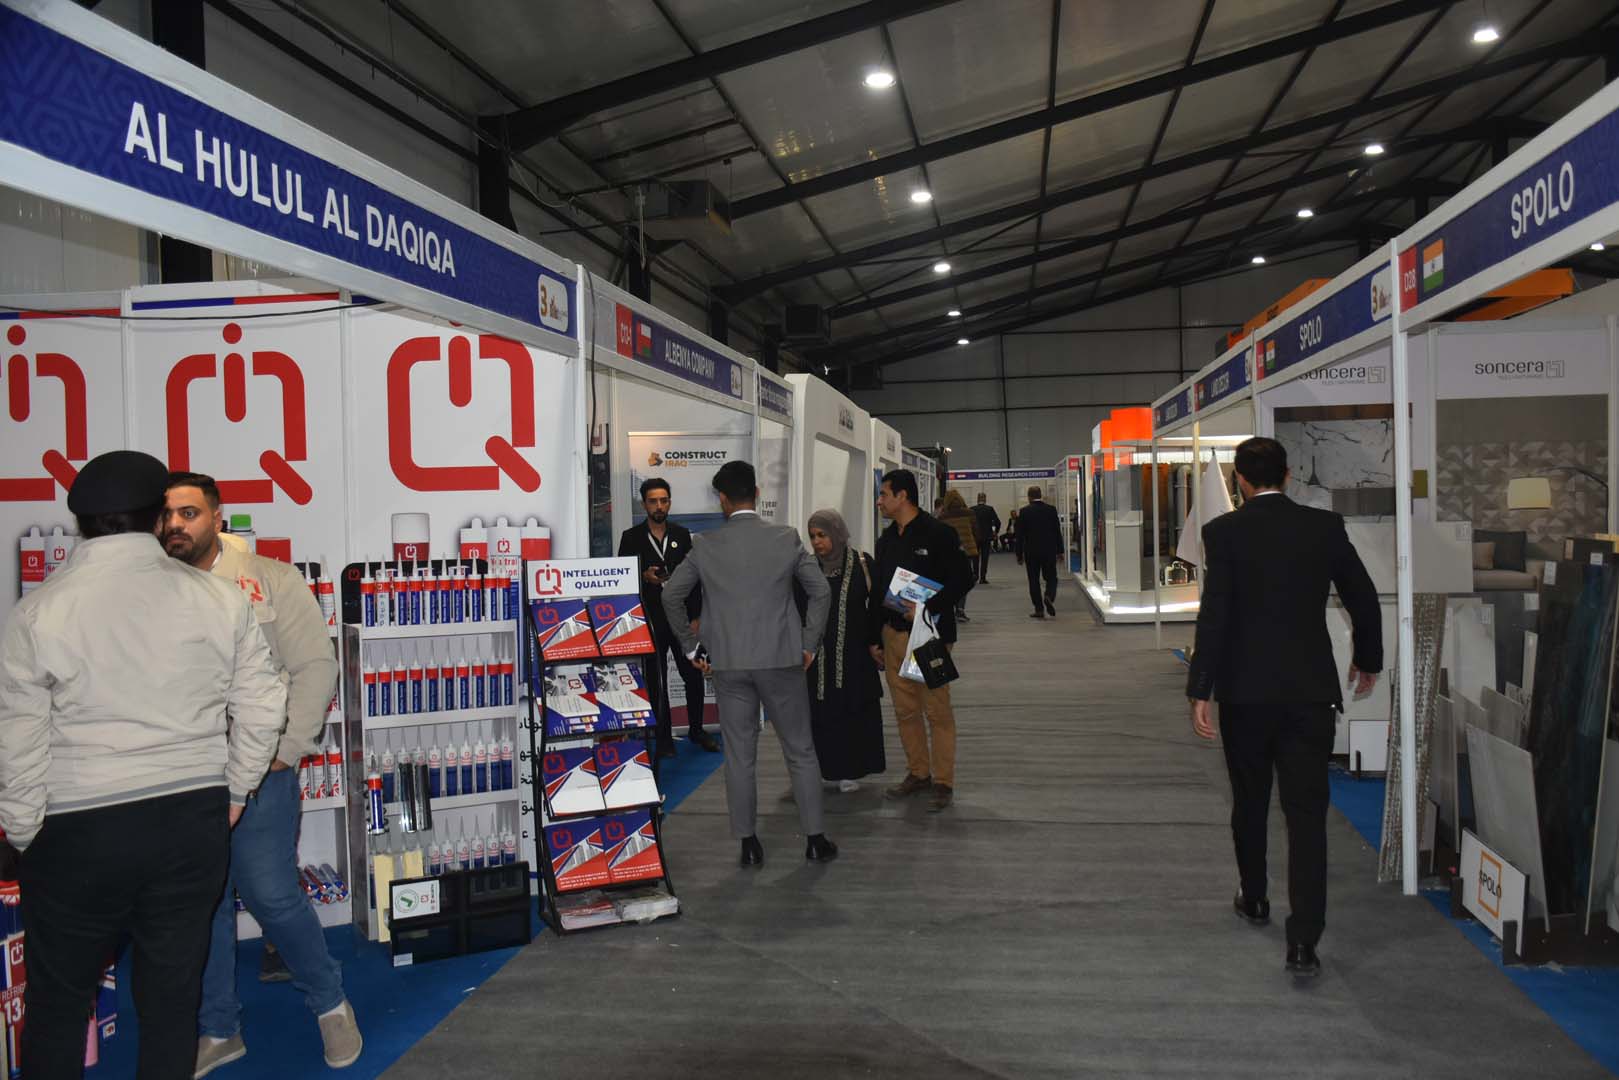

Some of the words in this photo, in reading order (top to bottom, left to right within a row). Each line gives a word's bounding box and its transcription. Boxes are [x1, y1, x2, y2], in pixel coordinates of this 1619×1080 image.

[124, 101, 184, 174] AL
[194, 130, 315, 224] HULUL
[322, 187, 360, 240] AL
[366, 205, 456, 277] DAQIQA
[1510, 160, 1574, 241] SPOLO
[1404, 269, 1416, 293] D28
[1300, 315, 1322, 351] SPOLO
[692, 351, 714, 380] COMPANY
[1474, 361, 1544, 374] soncera
[665, 451, 727, 459] CONSTRUCT
[563, 568, 630, 579] INTELLIGENT
[575, 579, 620, 589] QUALITY
[1480, 870, 1502, 898] SPOLO
